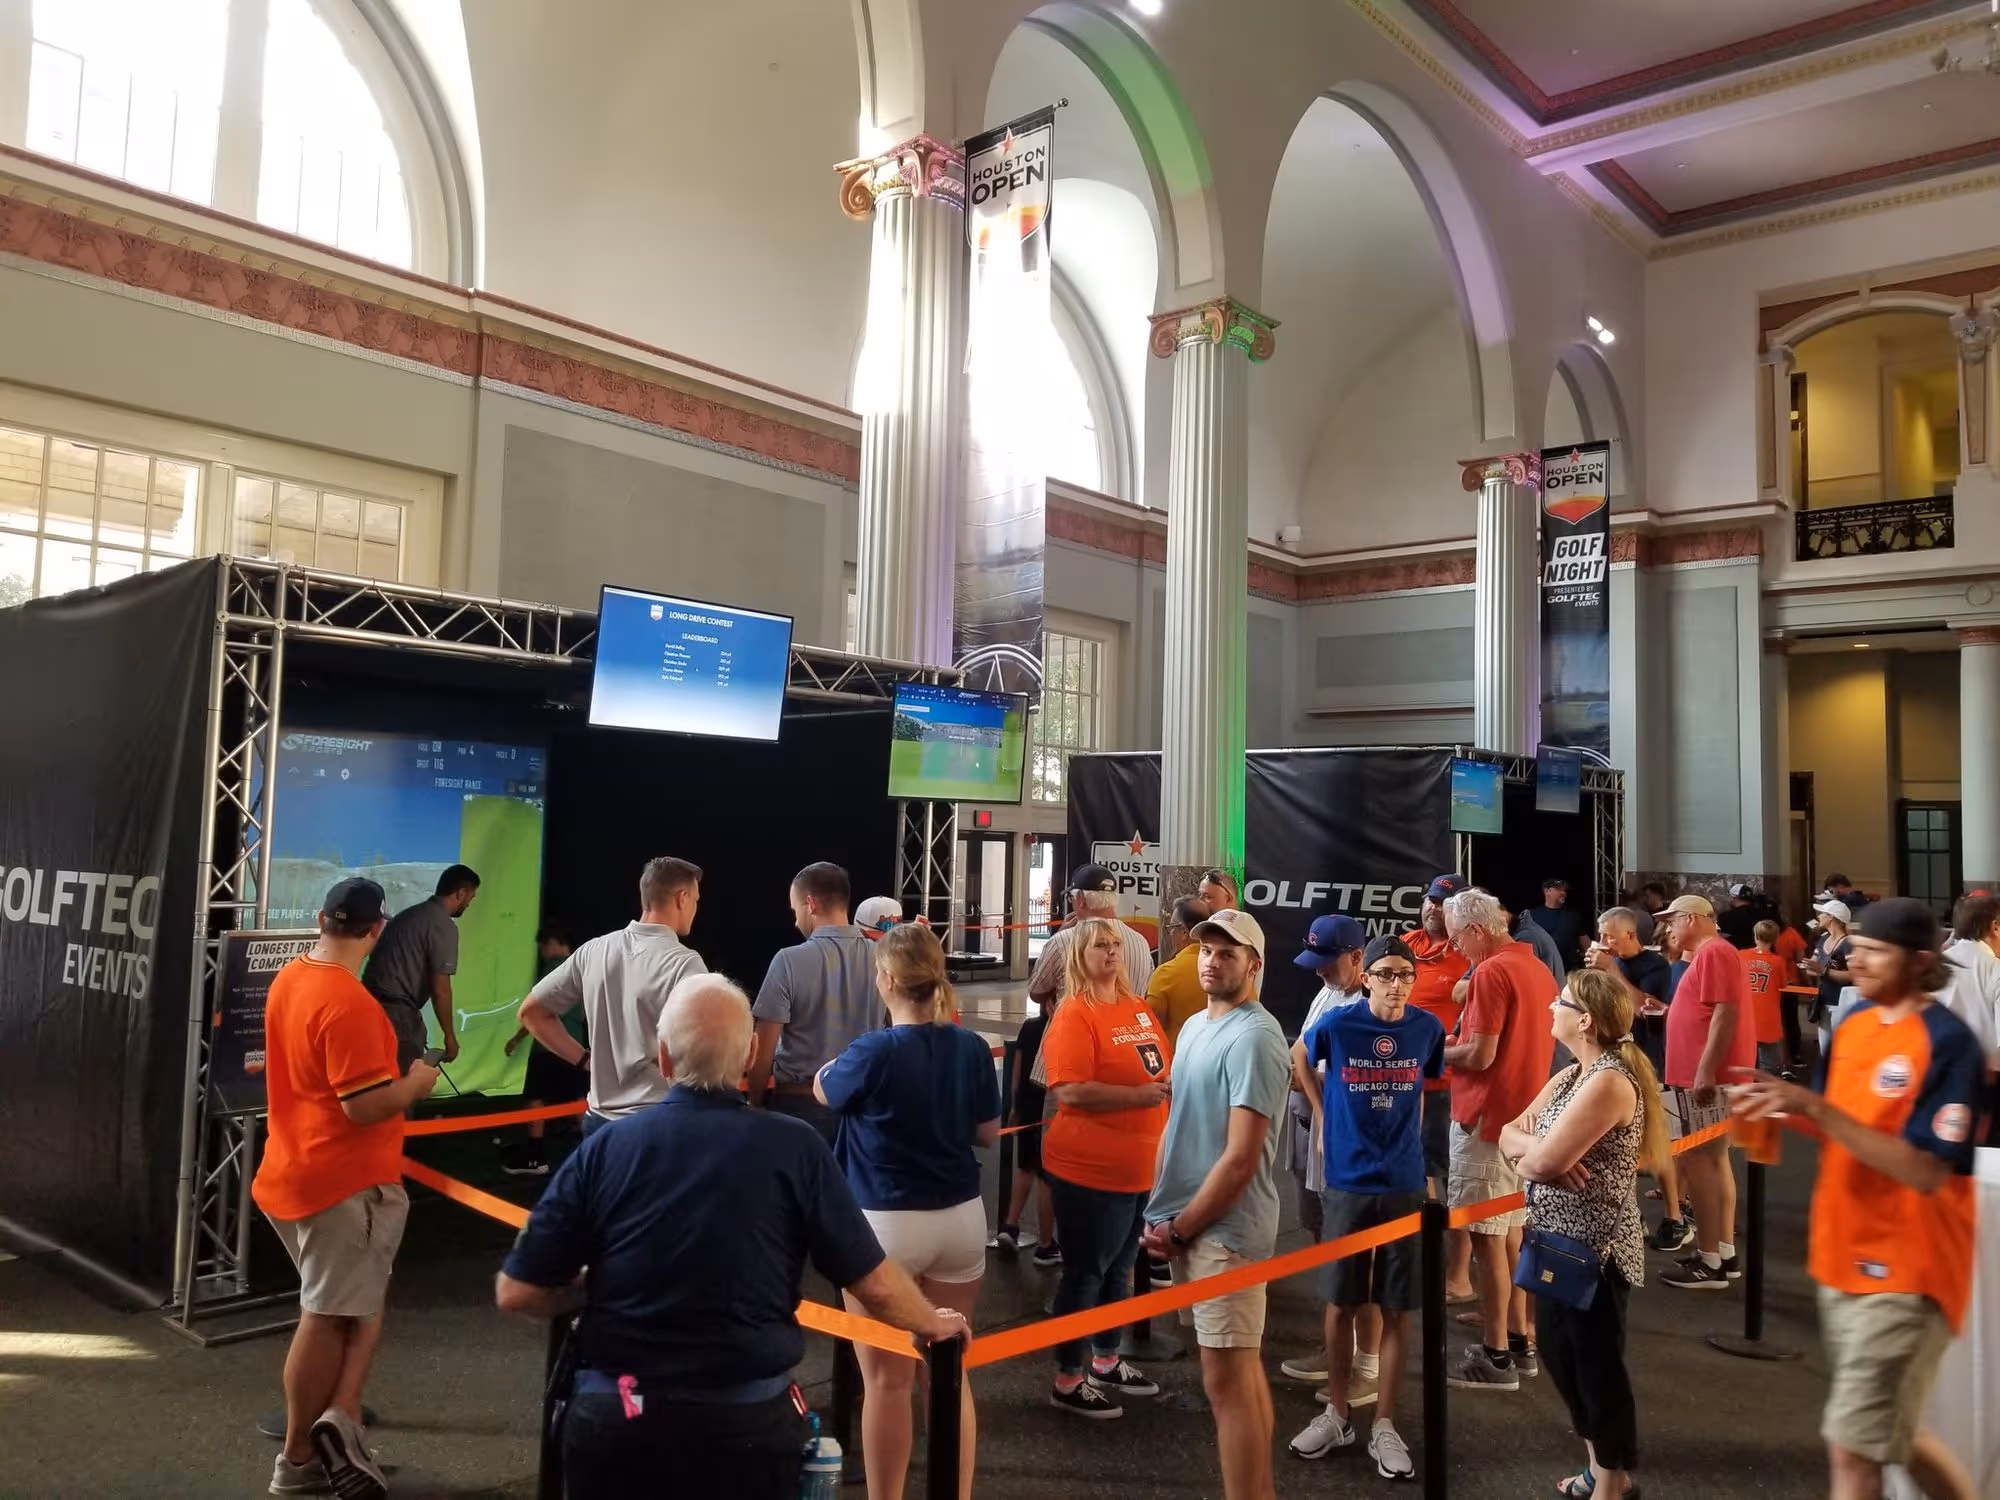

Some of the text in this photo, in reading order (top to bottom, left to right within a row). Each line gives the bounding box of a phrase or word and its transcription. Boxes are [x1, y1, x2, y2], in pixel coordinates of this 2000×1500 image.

[973, 145, 1045, 183] HOUSTON
[971, 161, 1044, 205] OPEN
[1547, 462, 1604, 477] HOUSTON
[1546, 471, 1603, 489] OPEN
[1556, 536, 1600, 559] GOLF
[1545, 560, 1603, 584] NIGHT
[1547, 592, 1601, 604] GOLFTEC
[1554, 586, 1585, 595] PRESENTED
[1574, 600, 1599, 608] EVENTS
[669, 611, 733, 628] LONG DRIVE CONTEST
[682, 633, 718, 644] LEADERBOARD
[304, 735, 373, 751] FORESIGHT
[469, 745, 475, 756] 4
[1099, 860, 1160, 873] HOUST
[1115, 875, 1160, 897] PE
[0, 864, 161, 940] OLFTEC
[1243, 879, 1423, 915] OLFTEC
[281, 909, 304, 919] PLAYER
[1353, 916, 1418, 938] NTS
[248, 941, 318, 956] LONGEST DRI
[62, 942, 150, 1000] EVENTS
[251, 957, 294, 970] COMPE
[1747, 971, 1770, 994] 27
[1349, 1057, 1418, 1069] WORLD SERIES
[1349, 1082, 1414, 1092] CHICAGO CUBS
[1371, 1101, 1393, 1109] SERIES
